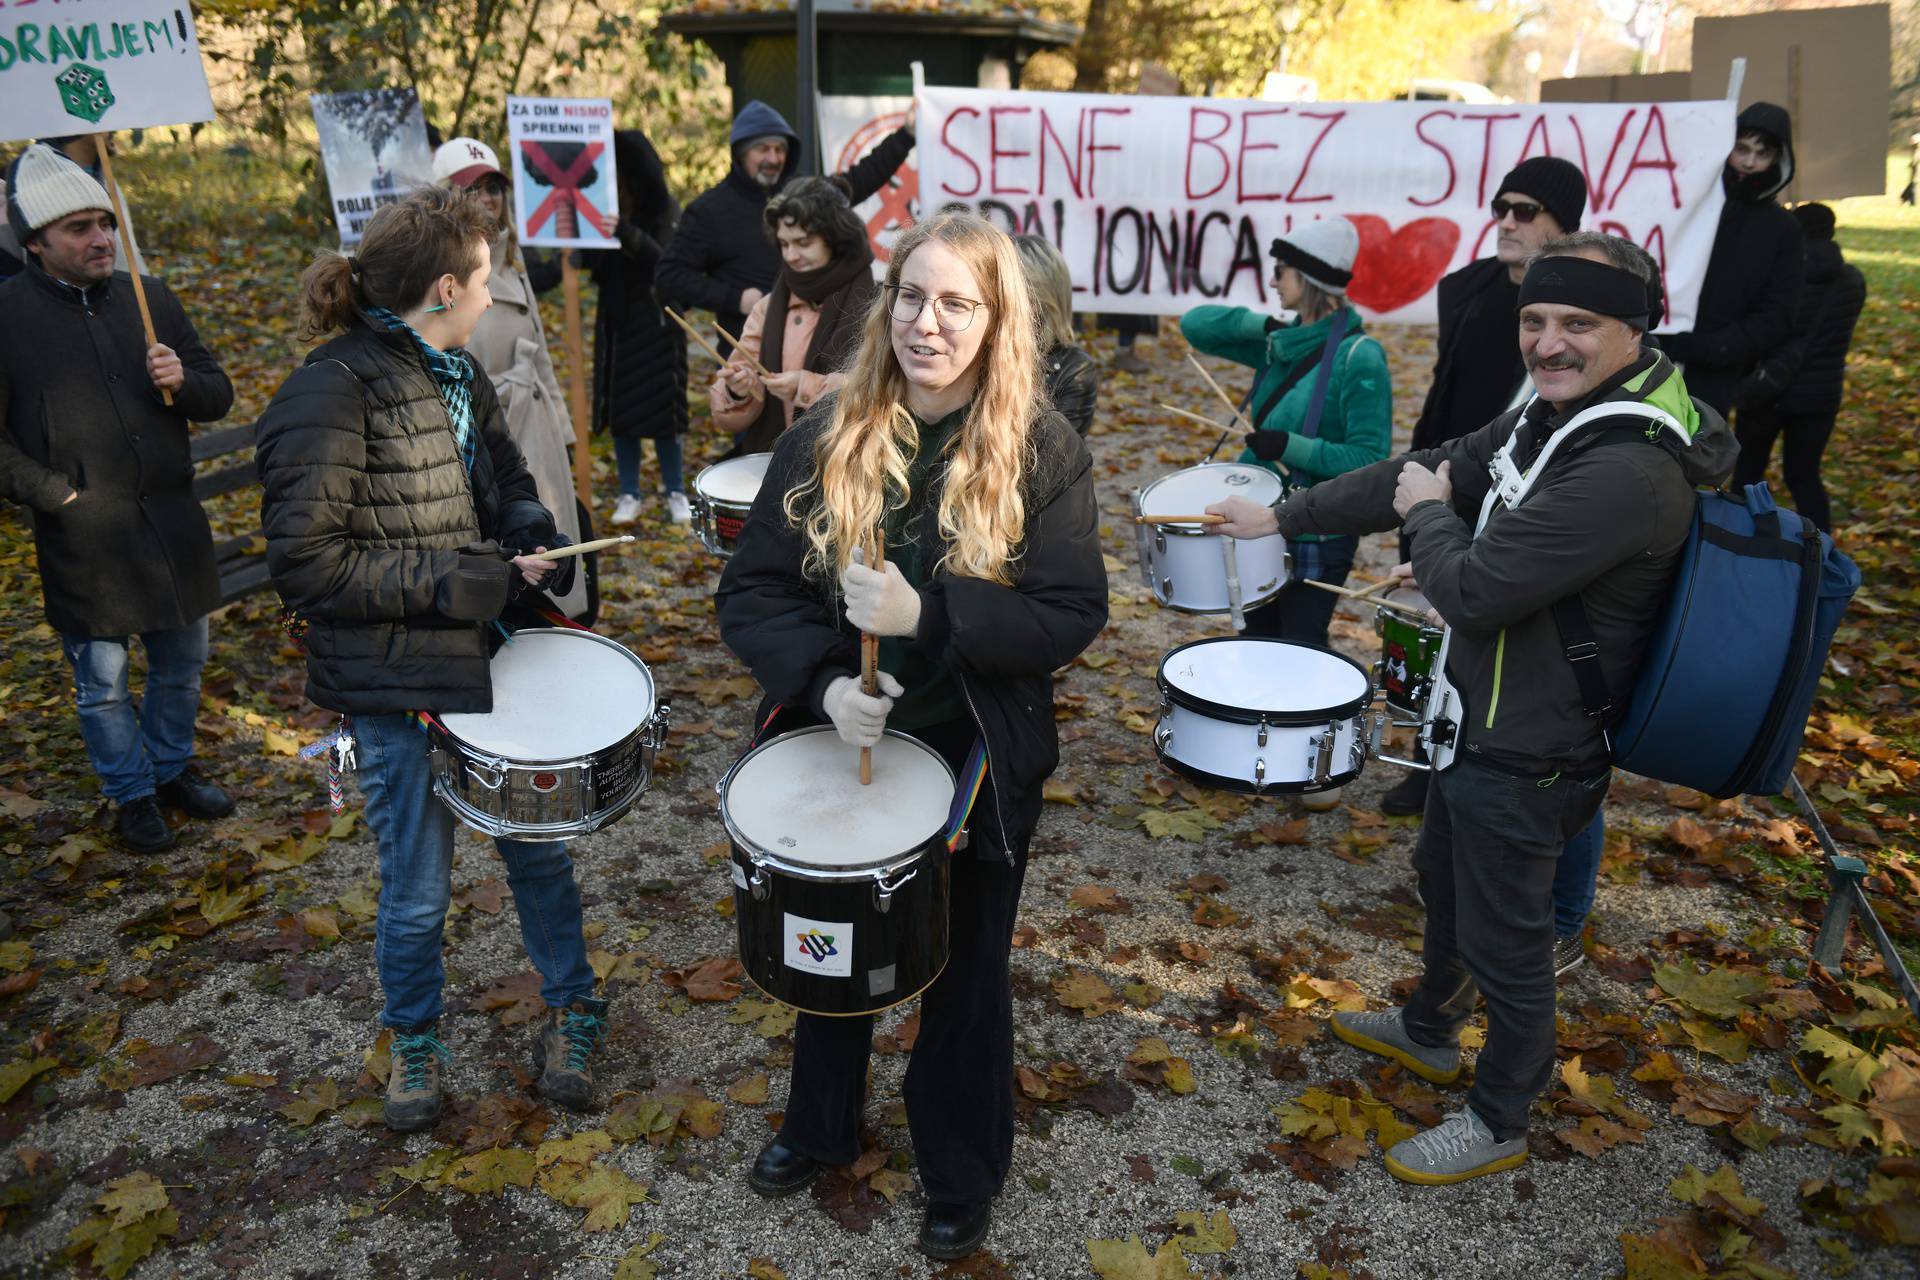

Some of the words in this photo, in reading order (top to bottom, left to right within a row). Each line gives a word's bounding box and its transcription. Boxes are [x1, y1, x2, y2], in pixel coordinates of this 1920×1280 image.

[511, 104, 529, 116] ZA
[533, 104, 559, 117] DIM
[563, 105, 609, 118] NISMO
[522, 122, 584, 134] SPREMNI
[588, 123, 601, 135] !!!
[466, 143, 485, 160] LA
[940, 106, 1132, 199] SENF
[1184, 106, 1346, 204] BEZ
[337, 196, 374, 214] BOLJE
[941, 199, 1267, 302] LIONICA
